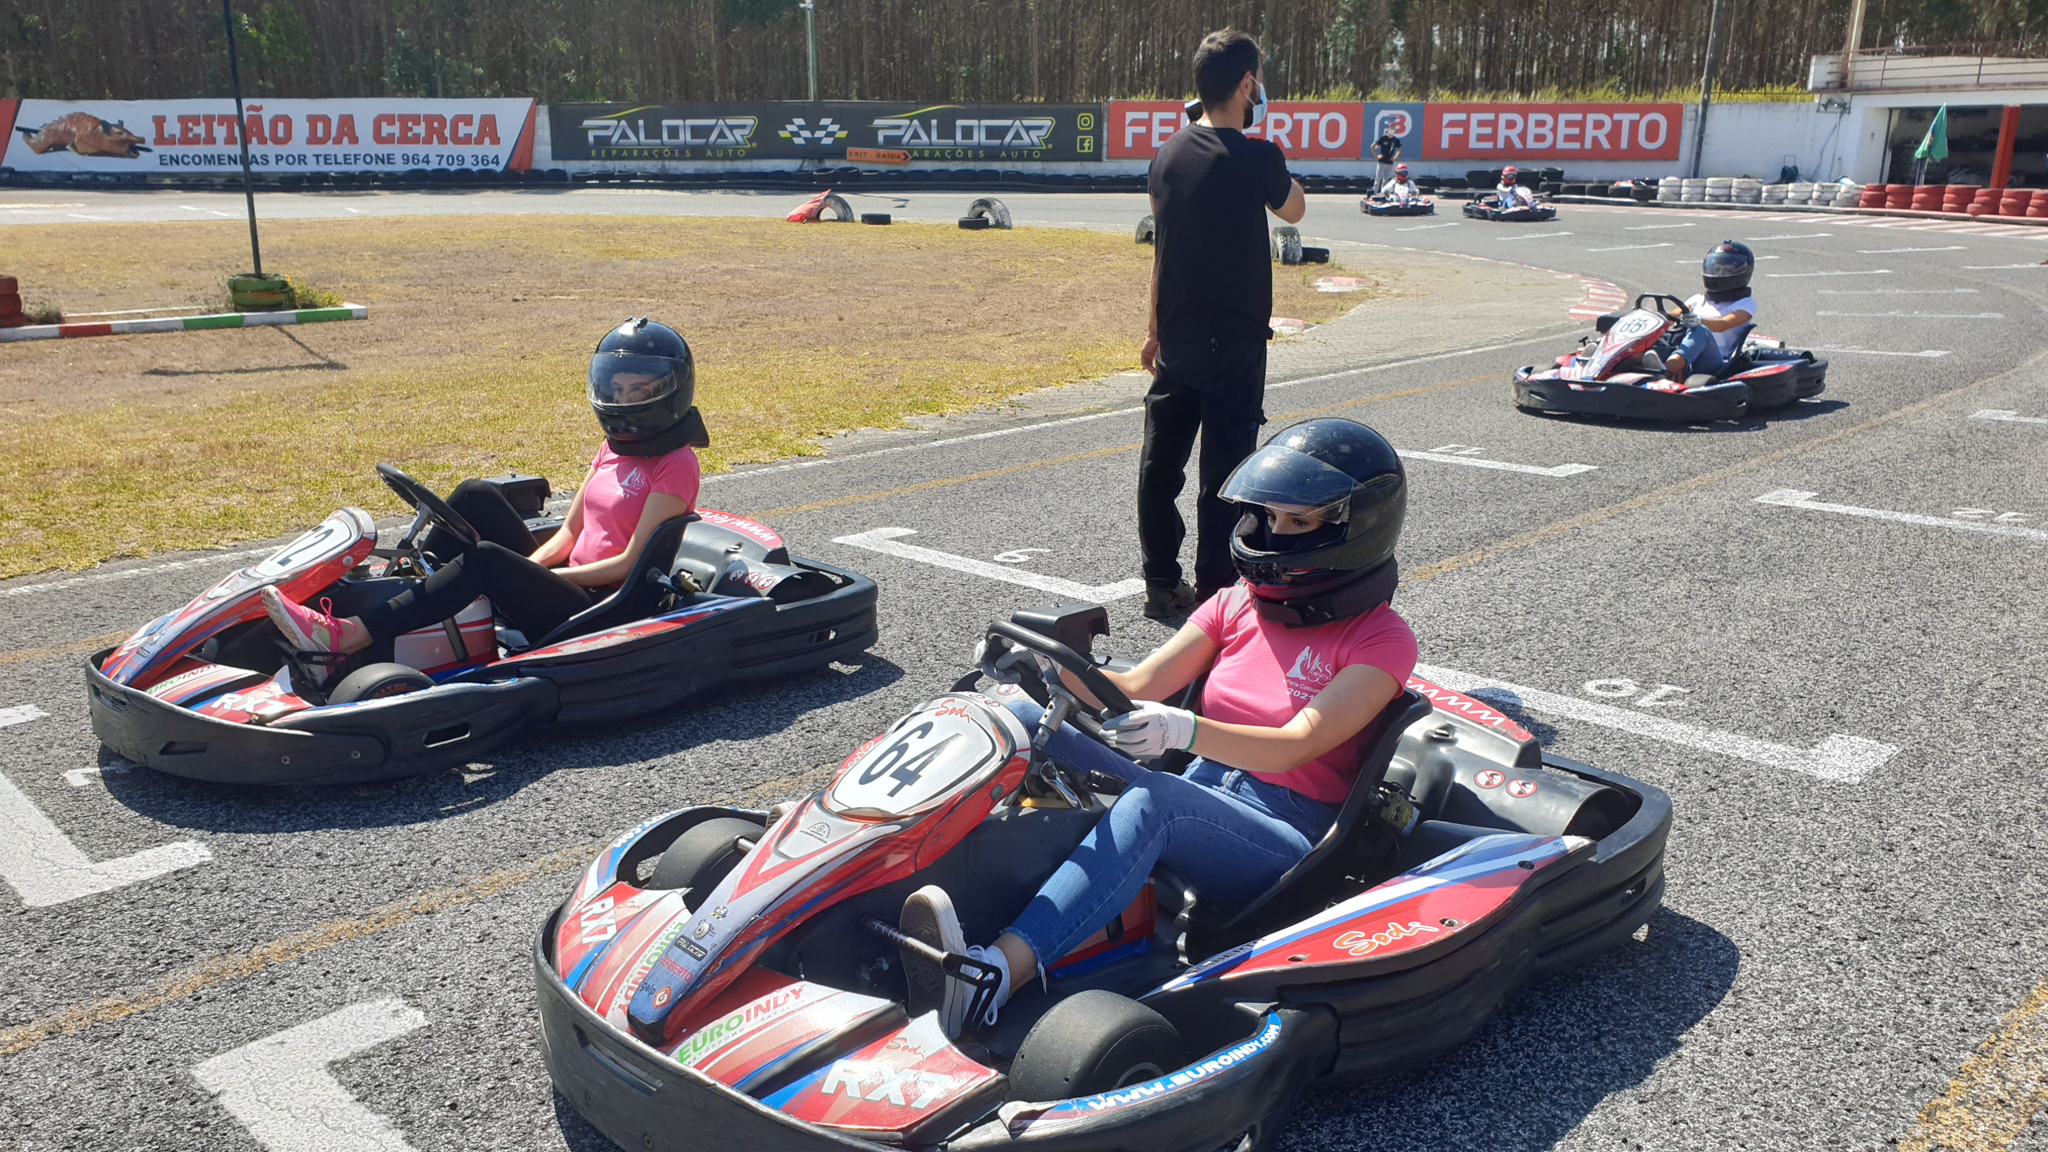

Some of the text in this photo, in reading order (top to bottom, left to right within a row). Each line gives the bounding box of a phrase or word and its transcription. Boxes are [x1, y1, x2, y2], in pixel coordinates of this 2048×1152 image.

[152, 104, 501, 146] LEITÃO DA CERCA
[581, 117, 758, 146] PALOCAR
[872, 117, 1055, 147] PALOCAR
[1125, 112, 1348, 149] FERTO
[1441, 112, 1668, 150] FERBERTO
[274, 153, 309, 167] POR
[312, 152, 396, 166] TELEFONE
[401, 152, 431, 166] 964
[435, 153, 465, 167] 709
[470, 154, 501, 167] 364
[591, 148, 746, 159] REPARAÇÕES AUTO
[876, 152, 901, 160] SAÍDA
[912, 149, 1041, 159] ARAÇÕES AUTO
[148, 663, 219, 696] UROINDY
[210, 693, 286, 716] RX7
[934, 698, 972, 724] Sodi
[858, 720, 963, 798] 64
[580, 895, 618, 945] RX7
[1332, 921, 1440, 956] Sodi
[639, 981, 657, 998] galp
[678, 984, 806, 1065] EUROINDY
[885, 1036, 927, 1061] Sodi
[1086, 1023, 1280, 1111] WWW.EUROINDY.COM
[820, 1058, 954, 1110] RX7
